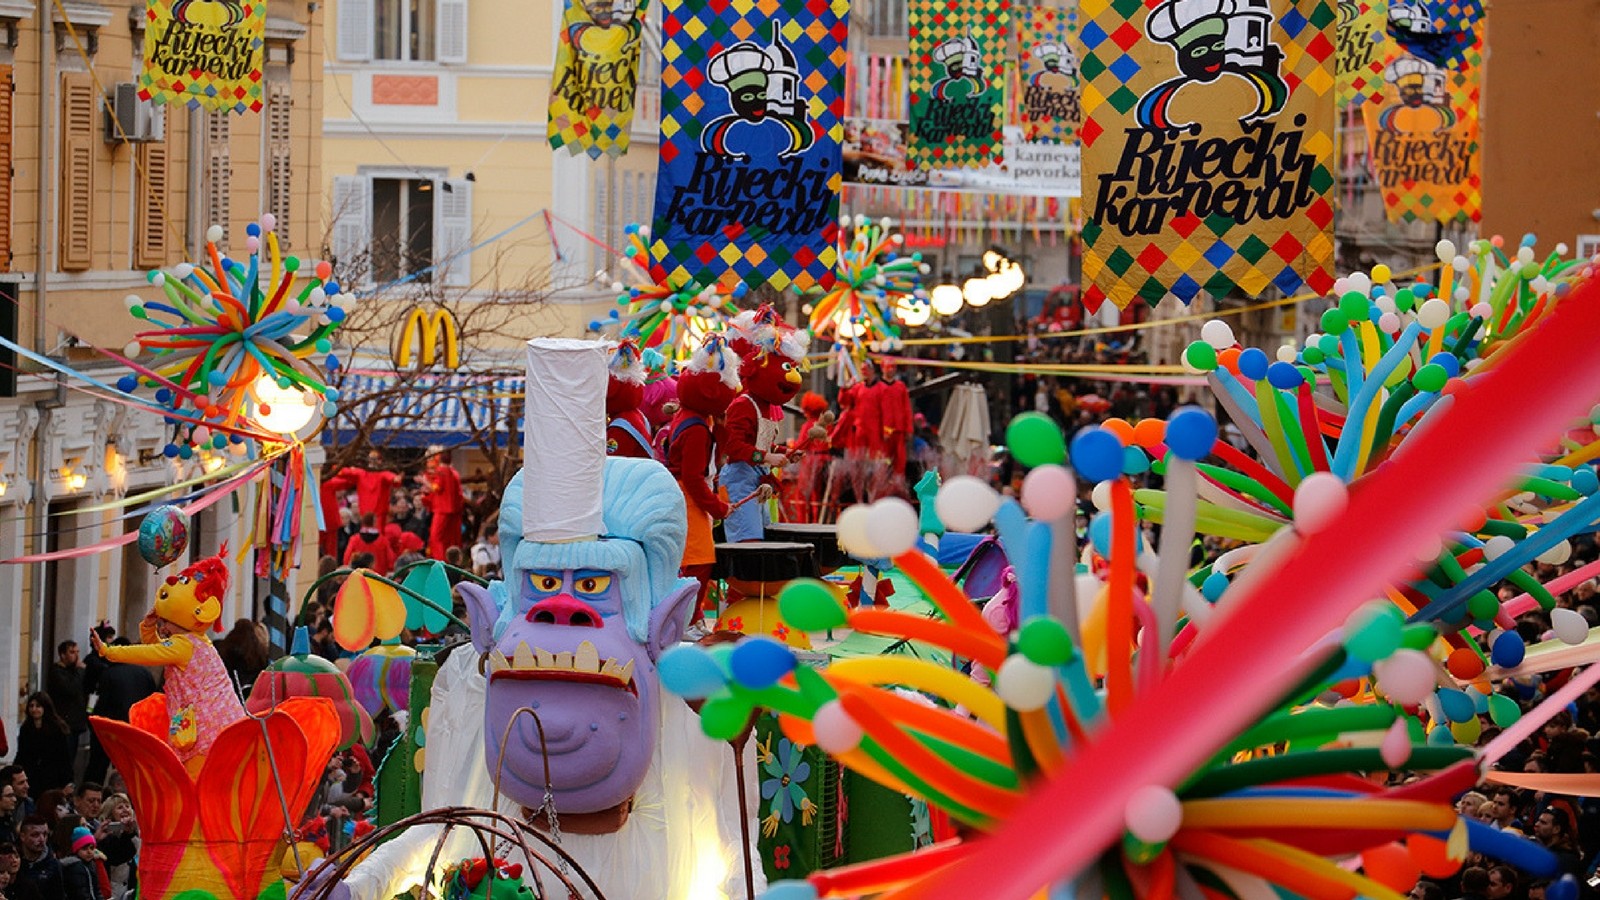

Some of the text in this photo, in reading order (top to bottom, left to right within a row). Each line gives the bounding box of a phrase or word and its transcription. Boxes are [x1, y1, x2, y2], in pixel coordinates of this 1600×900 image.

[151, 39, 255, 80] karneval
[914, 112, 996, 144] karneval
[1374, 130, 1470, 168] Riječki
[1112, 113, 1307, 195] Riječki
[686, 151, 830, 212] Riječki
[1093, 153, 1317, 236] karneval
[664, 185, 834, 236] karneval
